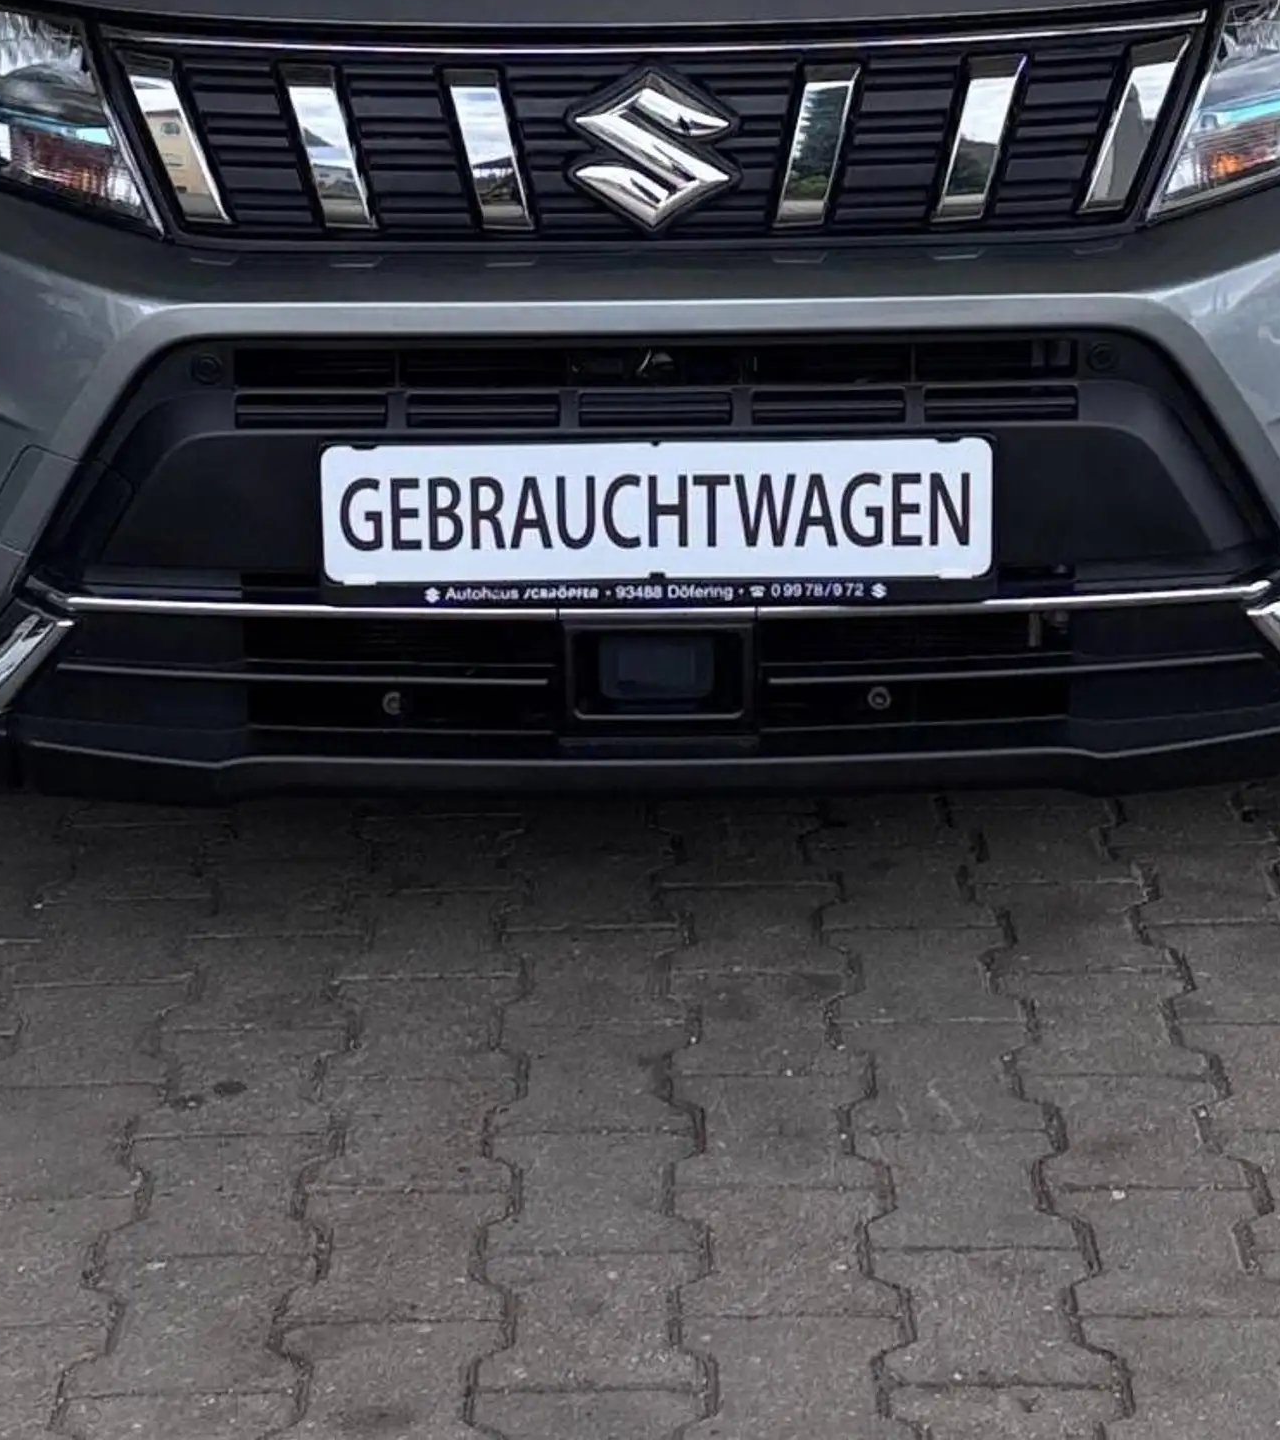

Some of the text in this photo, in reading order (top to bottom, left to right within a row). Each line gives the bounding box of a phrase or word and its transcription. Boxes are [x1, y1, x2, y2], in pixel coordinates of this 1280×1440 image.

[338, 471, 971, 552] GEBRAUCHTWAGEN
[444, 585, 520, 601] Autohaus
[666, 583, 734, 602] Döfering
